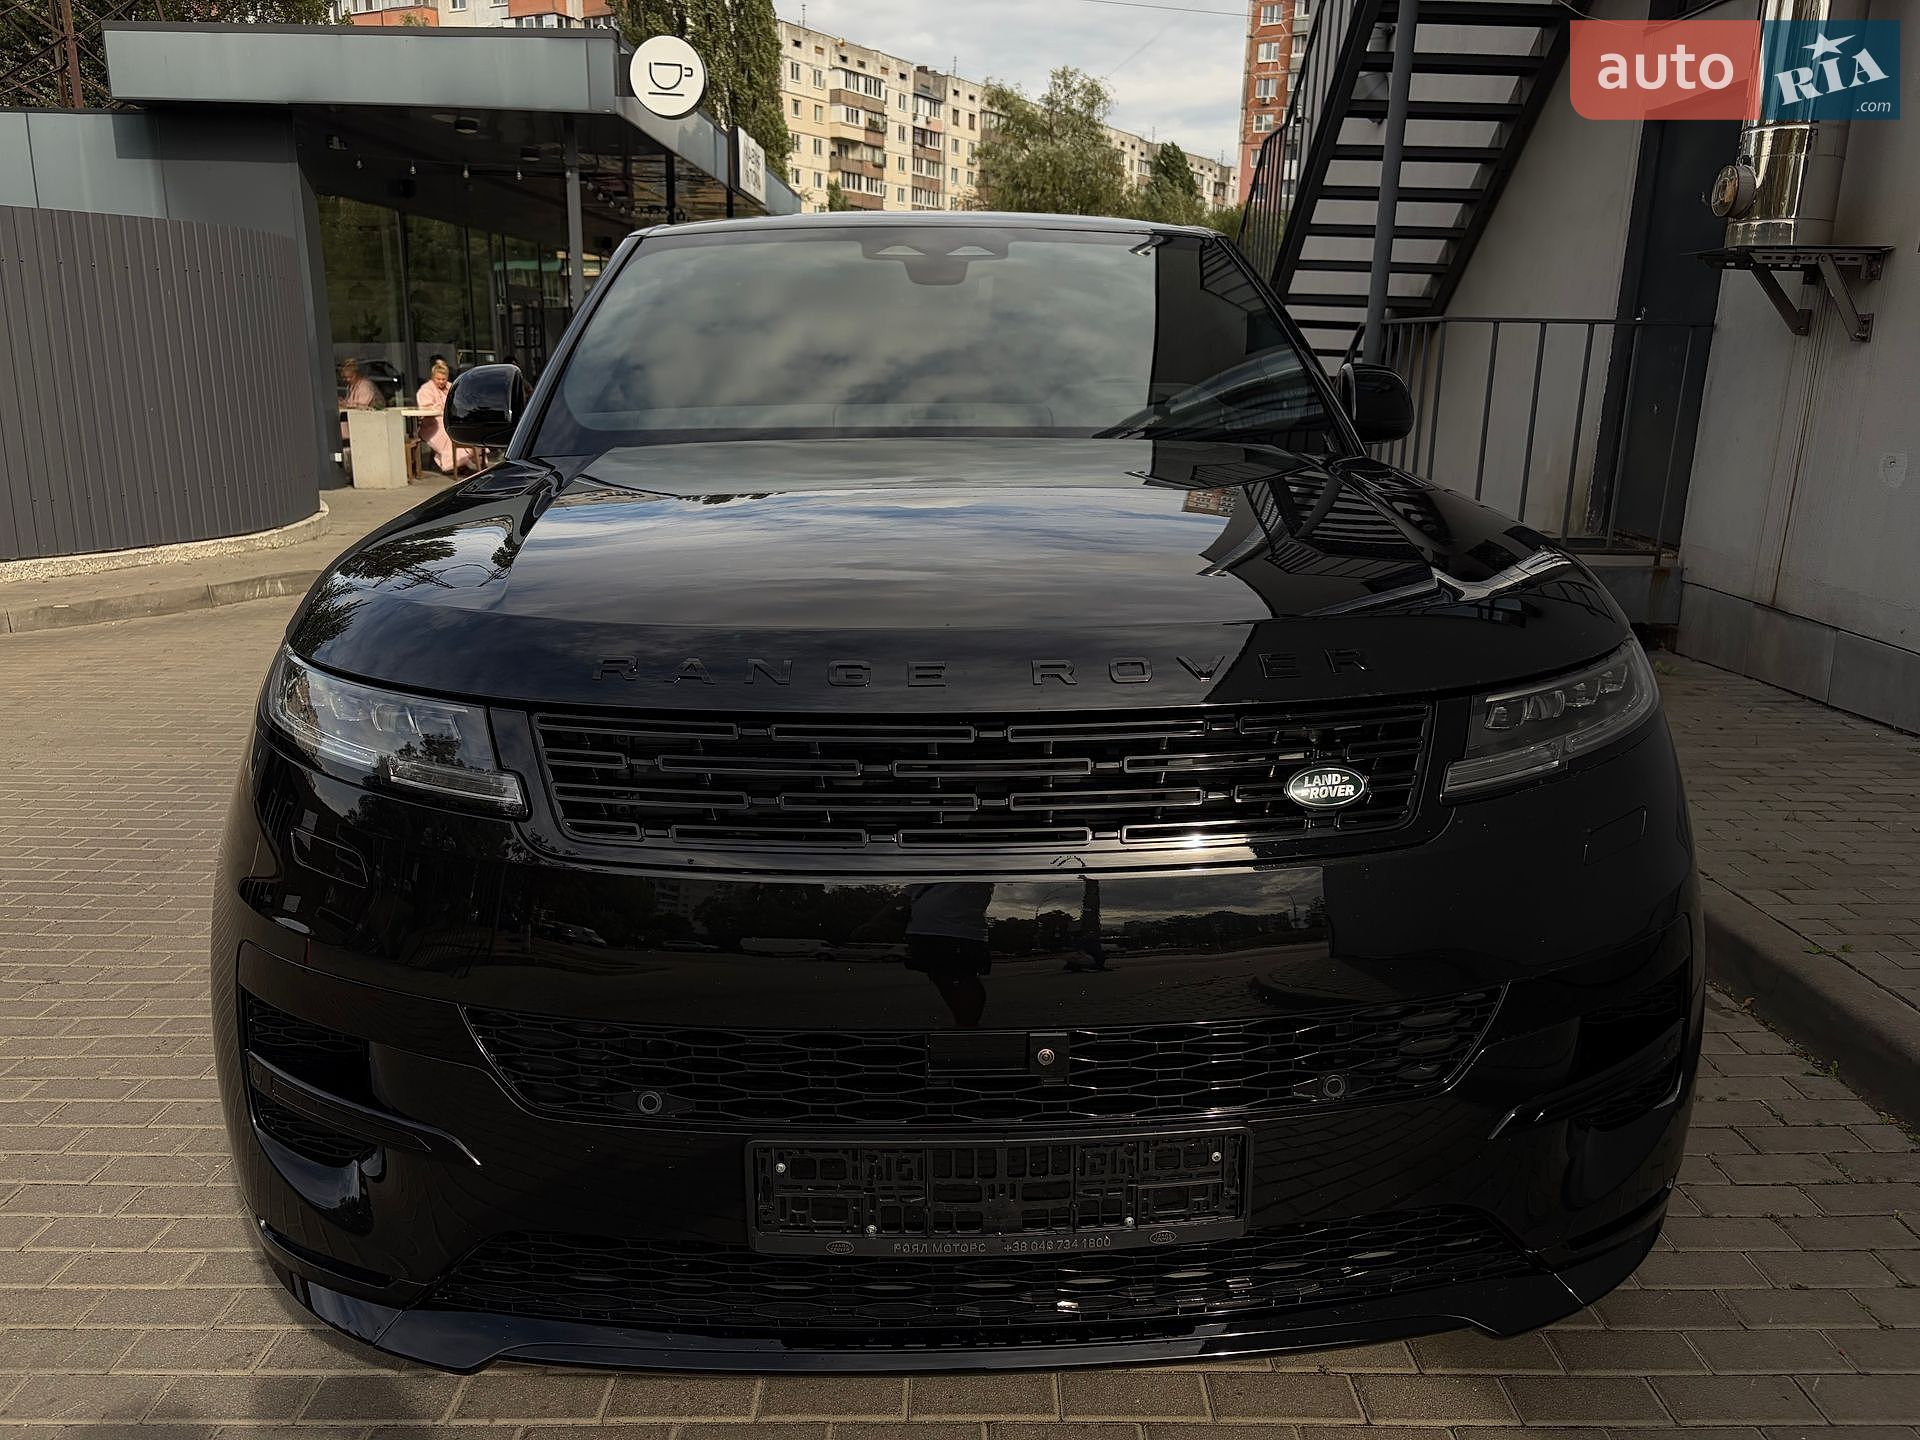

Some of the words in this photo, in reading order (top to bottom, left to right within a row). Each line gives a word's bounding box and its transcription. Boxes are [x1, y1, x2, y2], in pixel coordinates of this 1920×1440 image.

[591, 653, 948, 688] RANGE
[1030, 646, 1374, 686] ROVER
[1304, 773, 1341, 788] LAND
[1309, 784, 1355, 800] ROVER
[892, 1242, 928, 1254] РОЯЛ
[931, 1242, 987, 1254] МОТОРС
